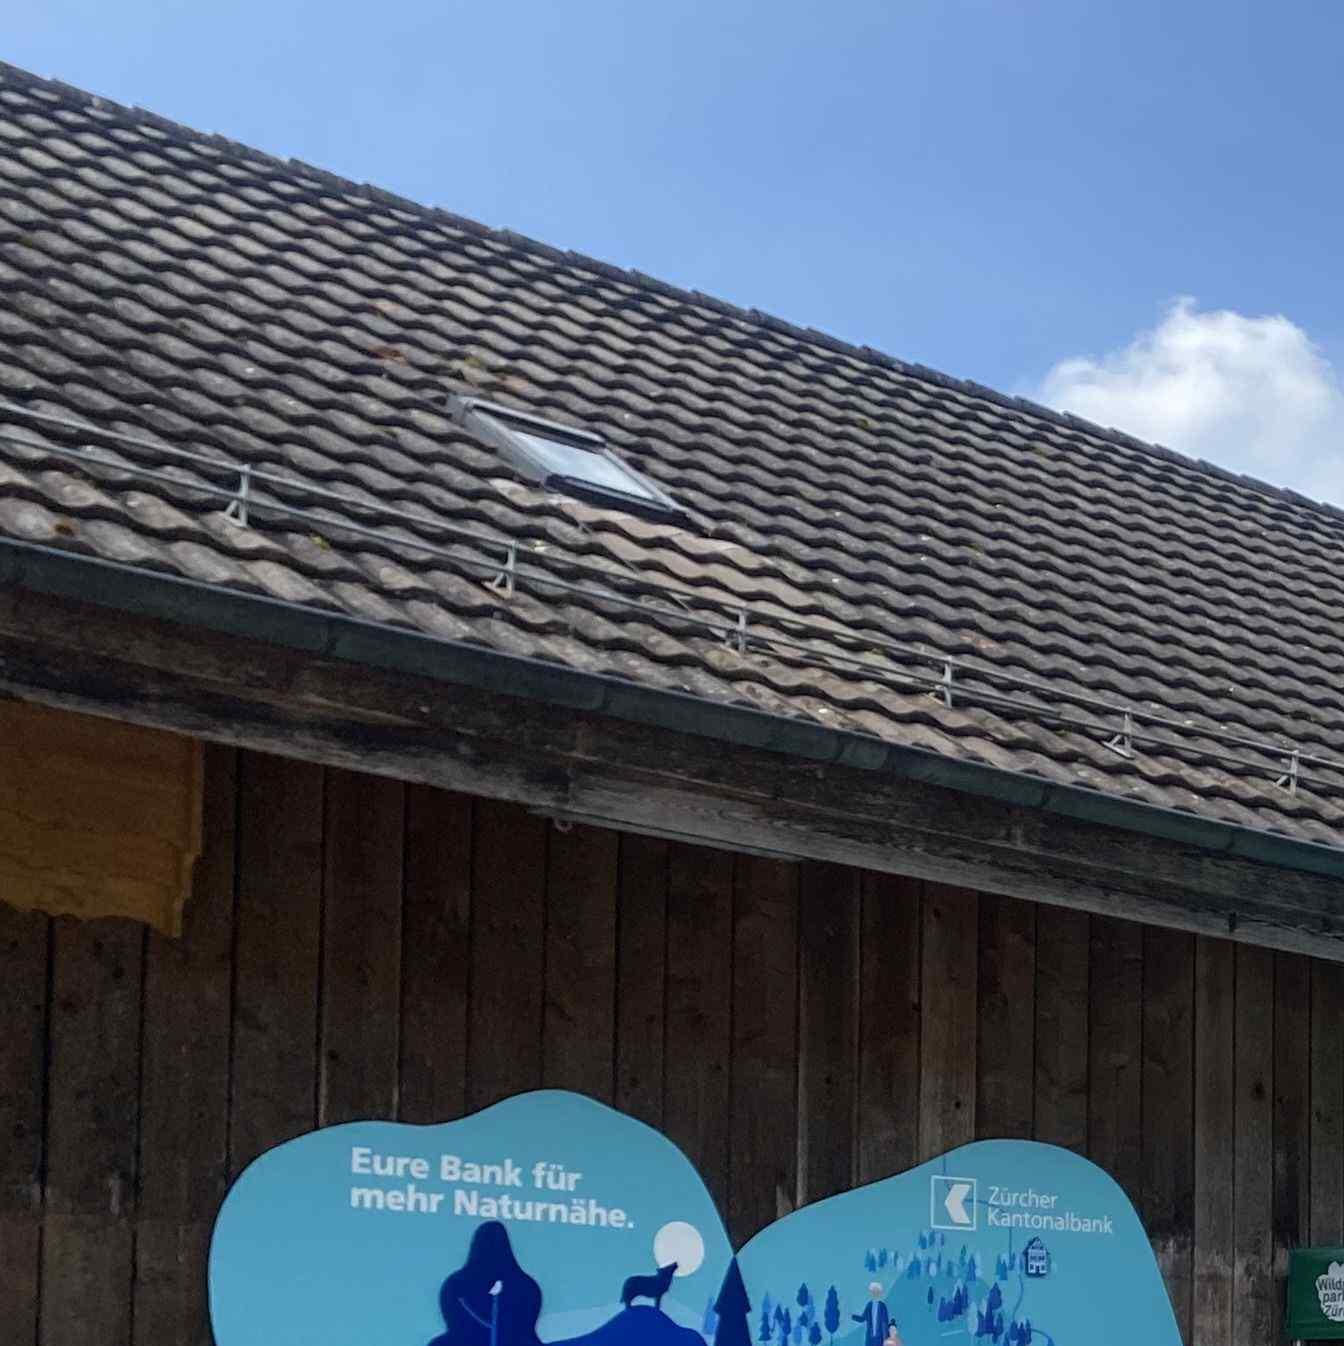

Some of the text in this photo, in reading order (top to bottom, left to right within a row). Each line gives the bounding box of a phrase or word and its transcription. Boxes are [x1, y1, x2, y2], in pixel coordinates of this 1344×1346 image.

[350, 1147, 582, 1191] Eure Bank für
[350, 1184, 635, 1229] mehr Naturnähe.
[987, 1185, 1059, 1208] Zürcher
[987, 1209, 1113, 1235] Kantonalbank
